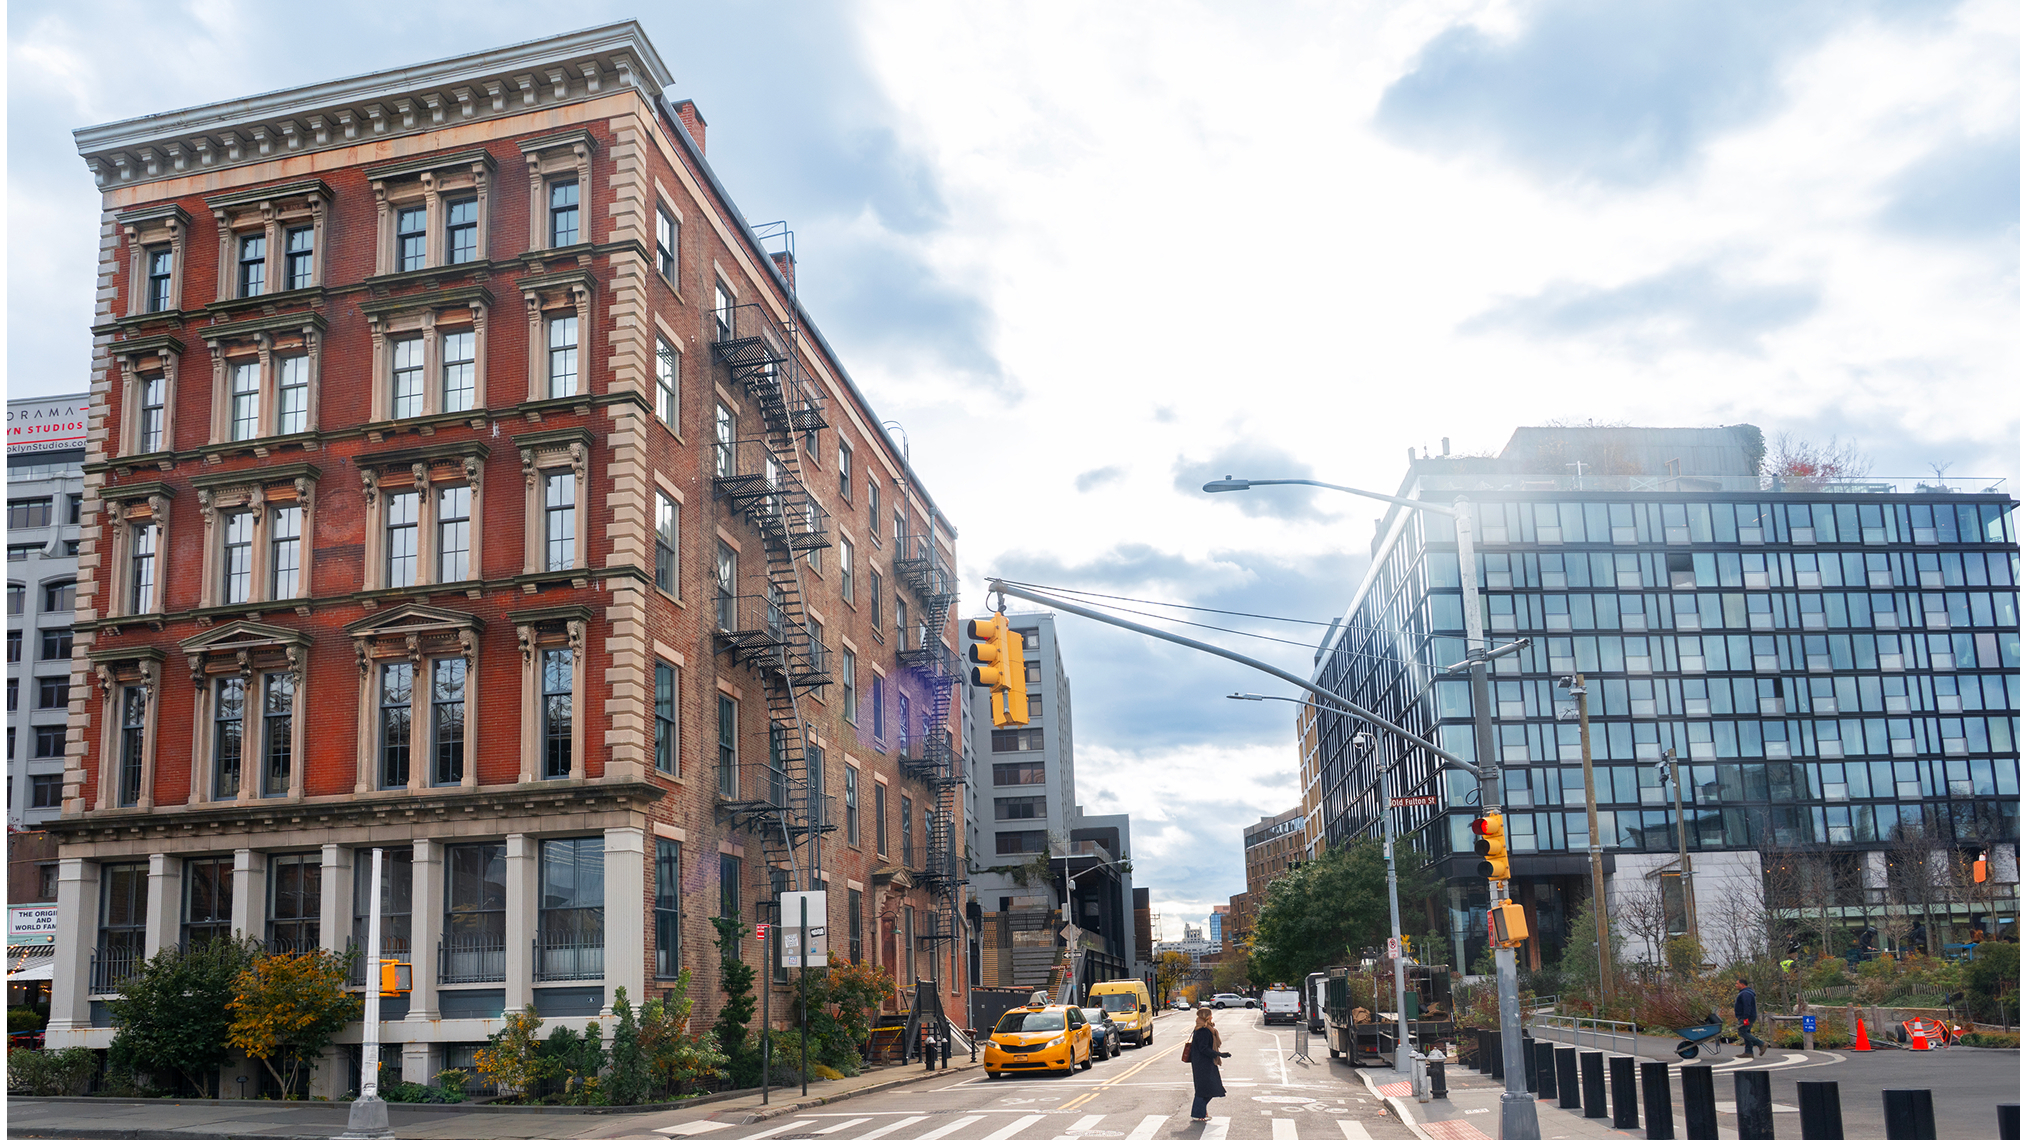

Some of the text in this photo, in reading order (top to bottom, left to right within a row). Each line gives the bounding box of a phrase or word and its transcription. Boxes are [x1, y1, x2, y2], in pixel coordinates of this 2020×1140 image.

[27, 421, 83, 434] STUDIOS
[1391, 796, 1435, 807] Old Fulton St
